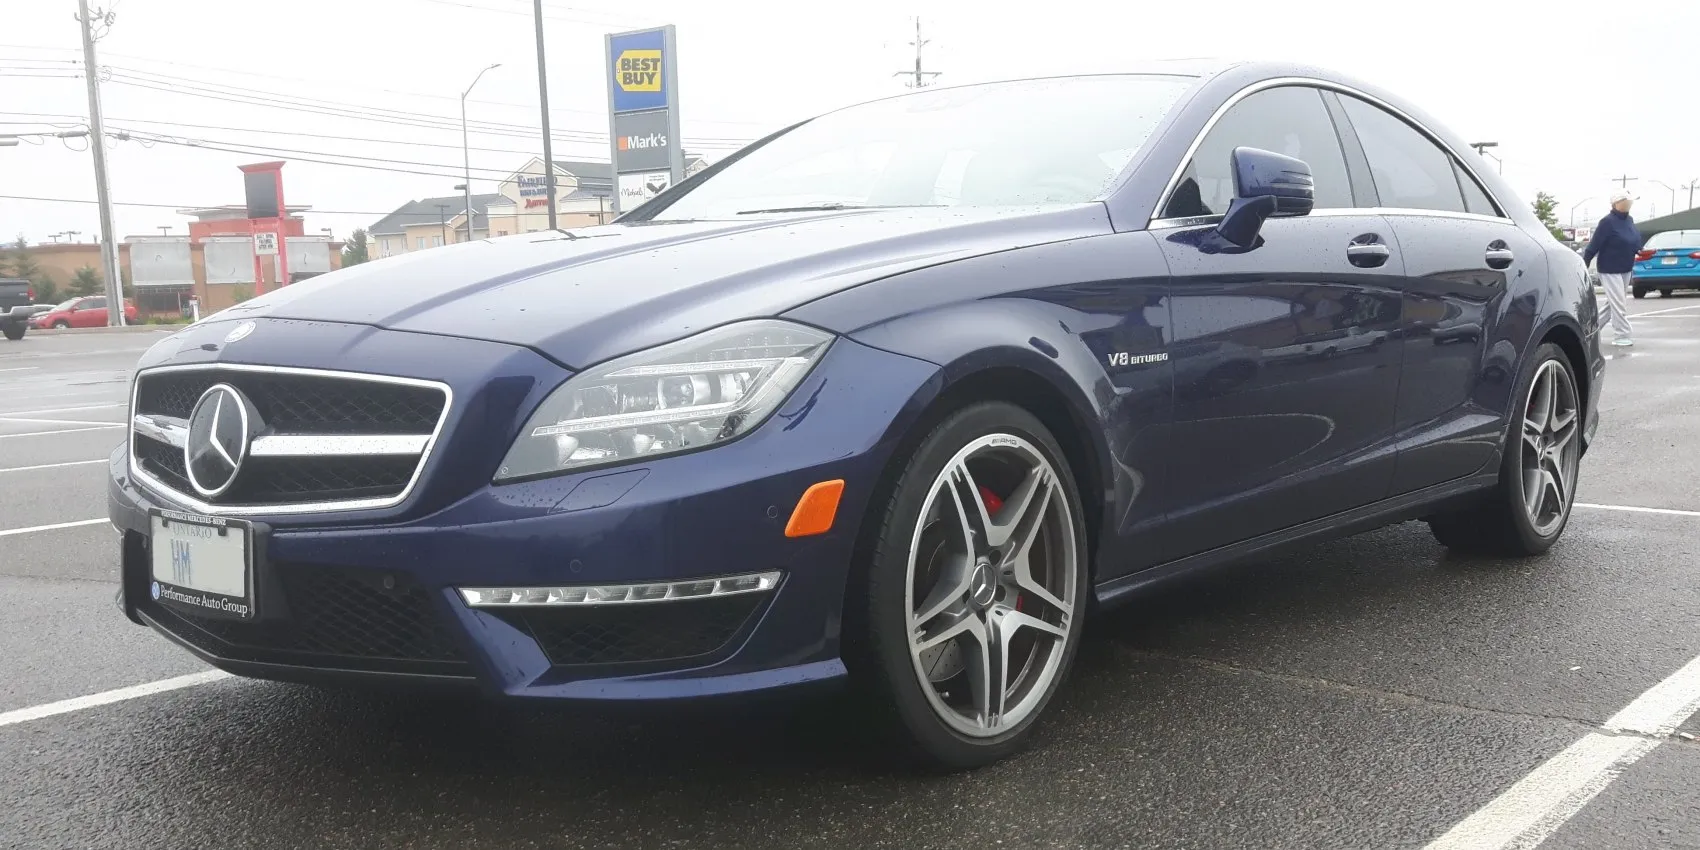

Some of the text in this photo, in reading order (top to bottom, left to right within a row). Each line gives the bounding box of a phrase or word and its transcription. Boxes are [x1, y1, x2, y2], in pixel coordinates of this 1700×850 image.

[621, 58, 660, 72] BEST
[622, 72, 657, 85] BUY
[627, 132, 667, 150] Mark's
[1107, 352, 1169, 367] V8 BITURBO
[1000, 437, 1017, 445] AMG
[187, 514, 227, 526] MERCEDES-BENZ
[170, 538, 192, 585] HM
[160, 584, 248, 617] Performance Auto Group
